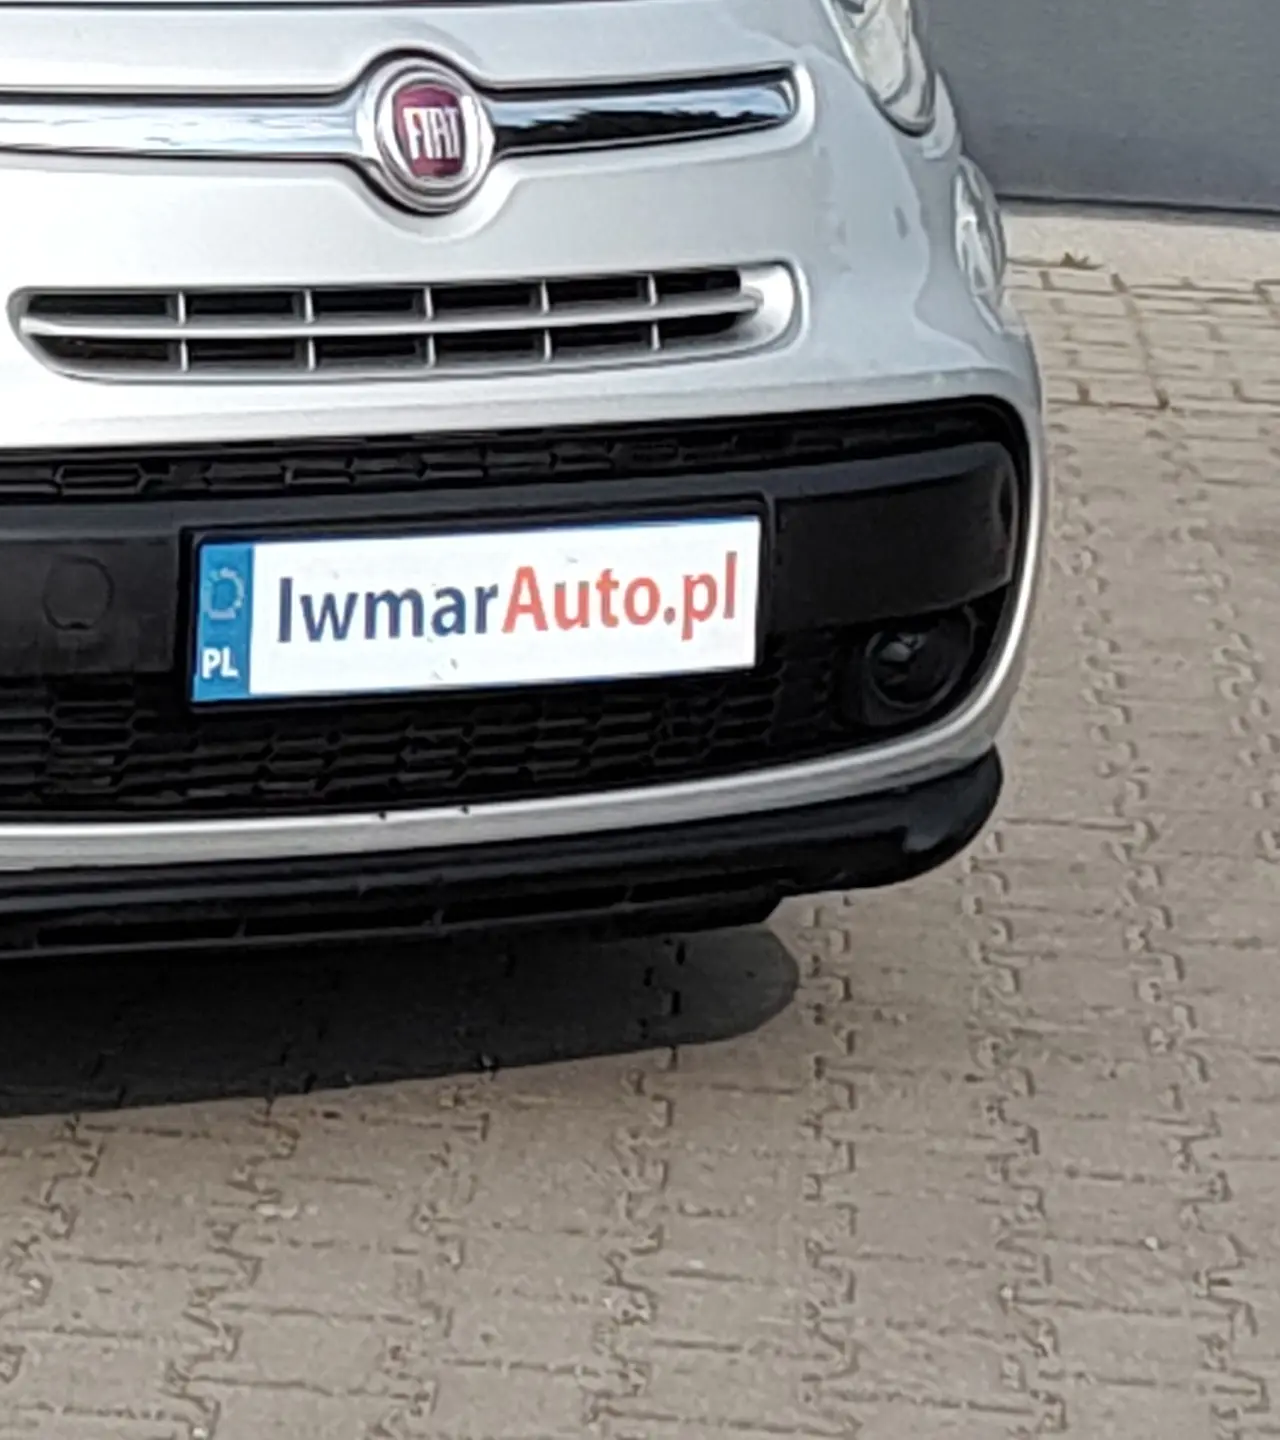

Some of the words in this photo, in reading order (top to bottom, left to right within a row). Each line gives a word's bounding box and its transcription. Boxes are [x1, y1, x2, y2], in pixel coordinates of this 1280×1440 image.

[402, 107, 461, 160] FIAT
[277, 551, 738, 643] IwmarAuto.pl
[202, 646, 239, 679] PL
